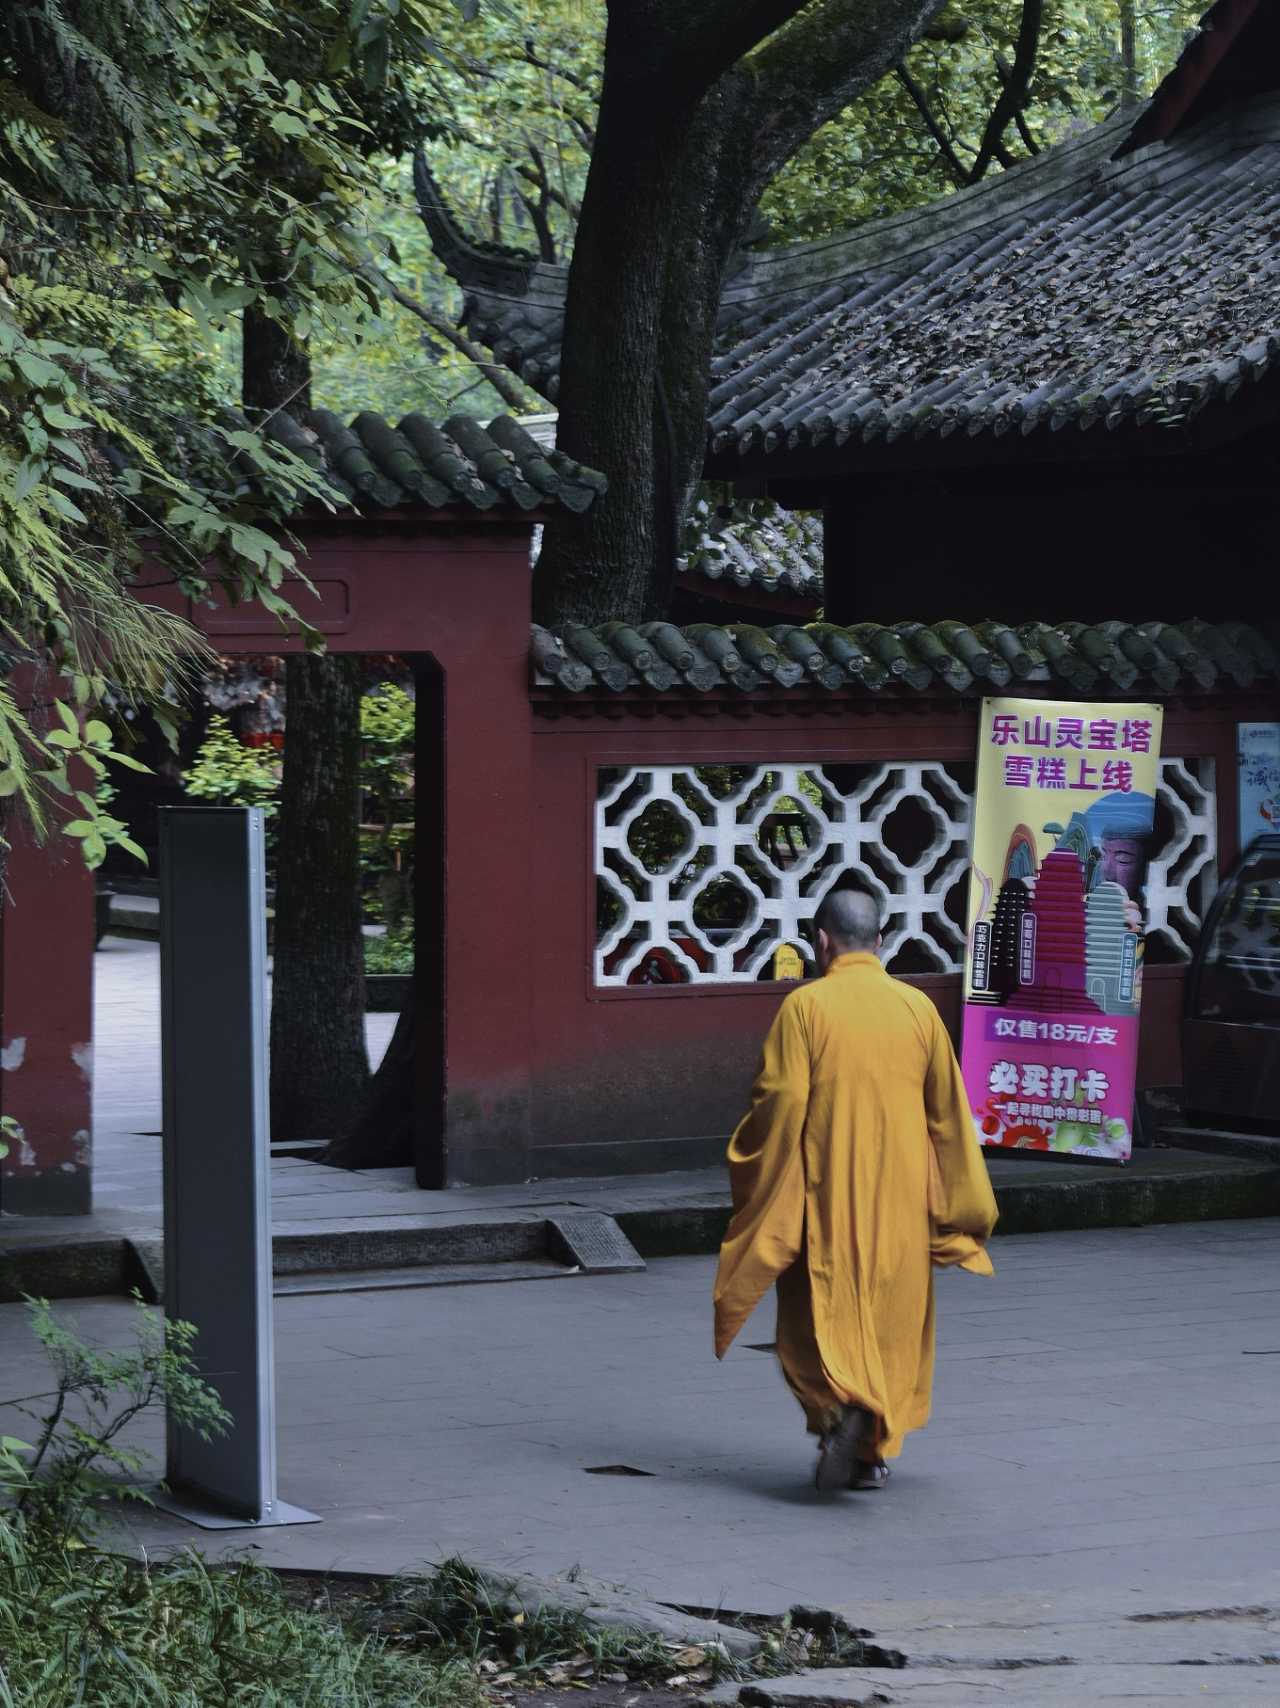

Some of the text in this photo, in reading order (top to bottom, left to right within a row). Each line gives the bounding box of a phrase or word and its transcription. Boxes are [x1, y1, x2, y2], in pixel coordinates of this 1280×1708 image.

[991, 715, 1152, 753] 乐山灵宝塔
[1005, 755, 1133, 792] 雪糕上线
[994, 1018, 1119, 1046] 仅售18元/支
[989, 1060, 1110, 1102] 必买打卡
